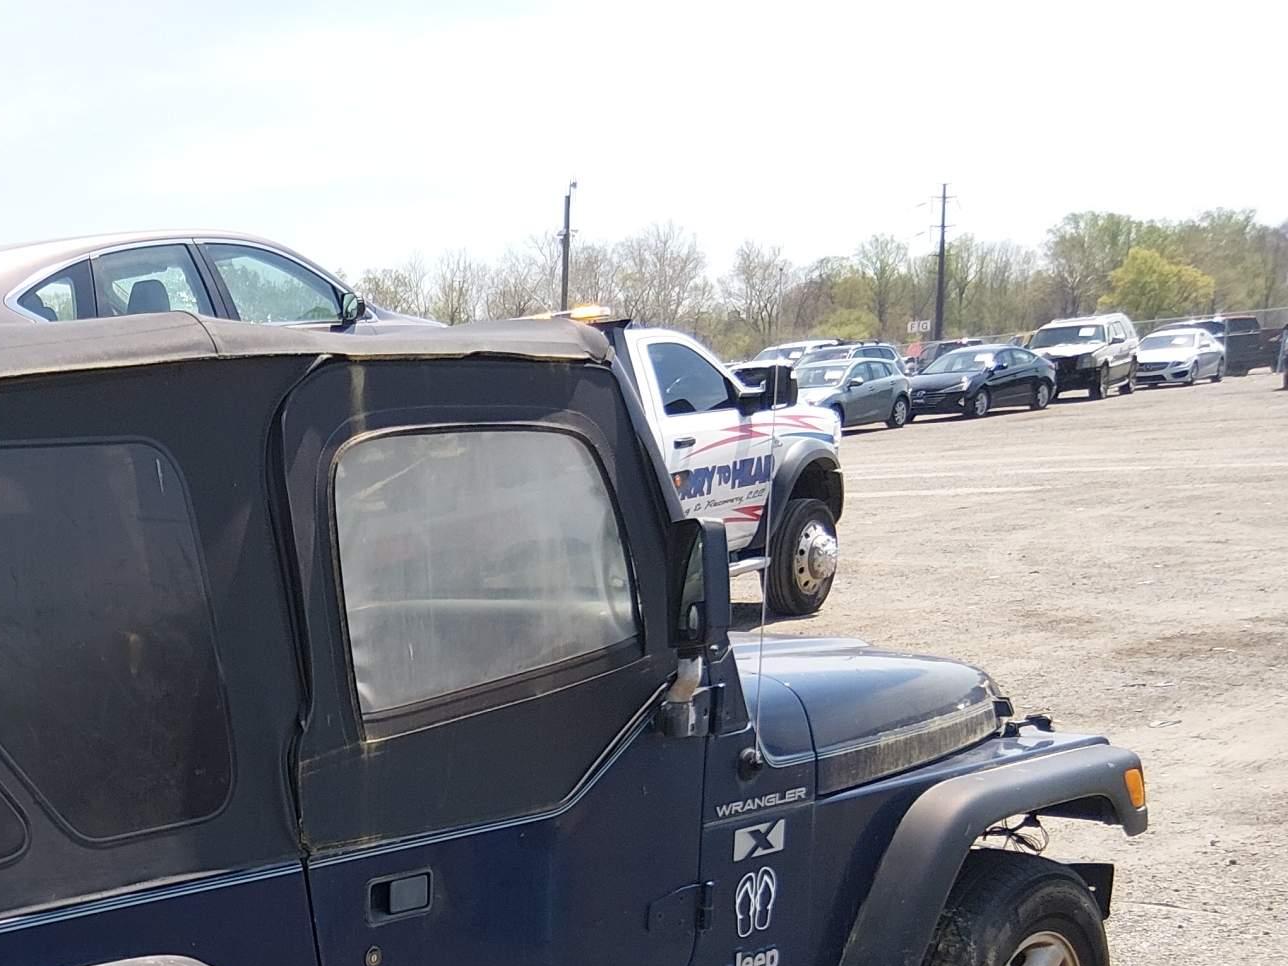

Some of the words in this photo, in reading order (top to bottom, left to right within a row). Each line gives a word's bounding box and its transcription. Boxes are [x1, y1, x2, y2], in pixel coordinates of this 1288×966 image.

[716, 464, 731, 486] TO
[715, 786, 808, 818] WRANGLER
[733, 818, 786, 862] X
